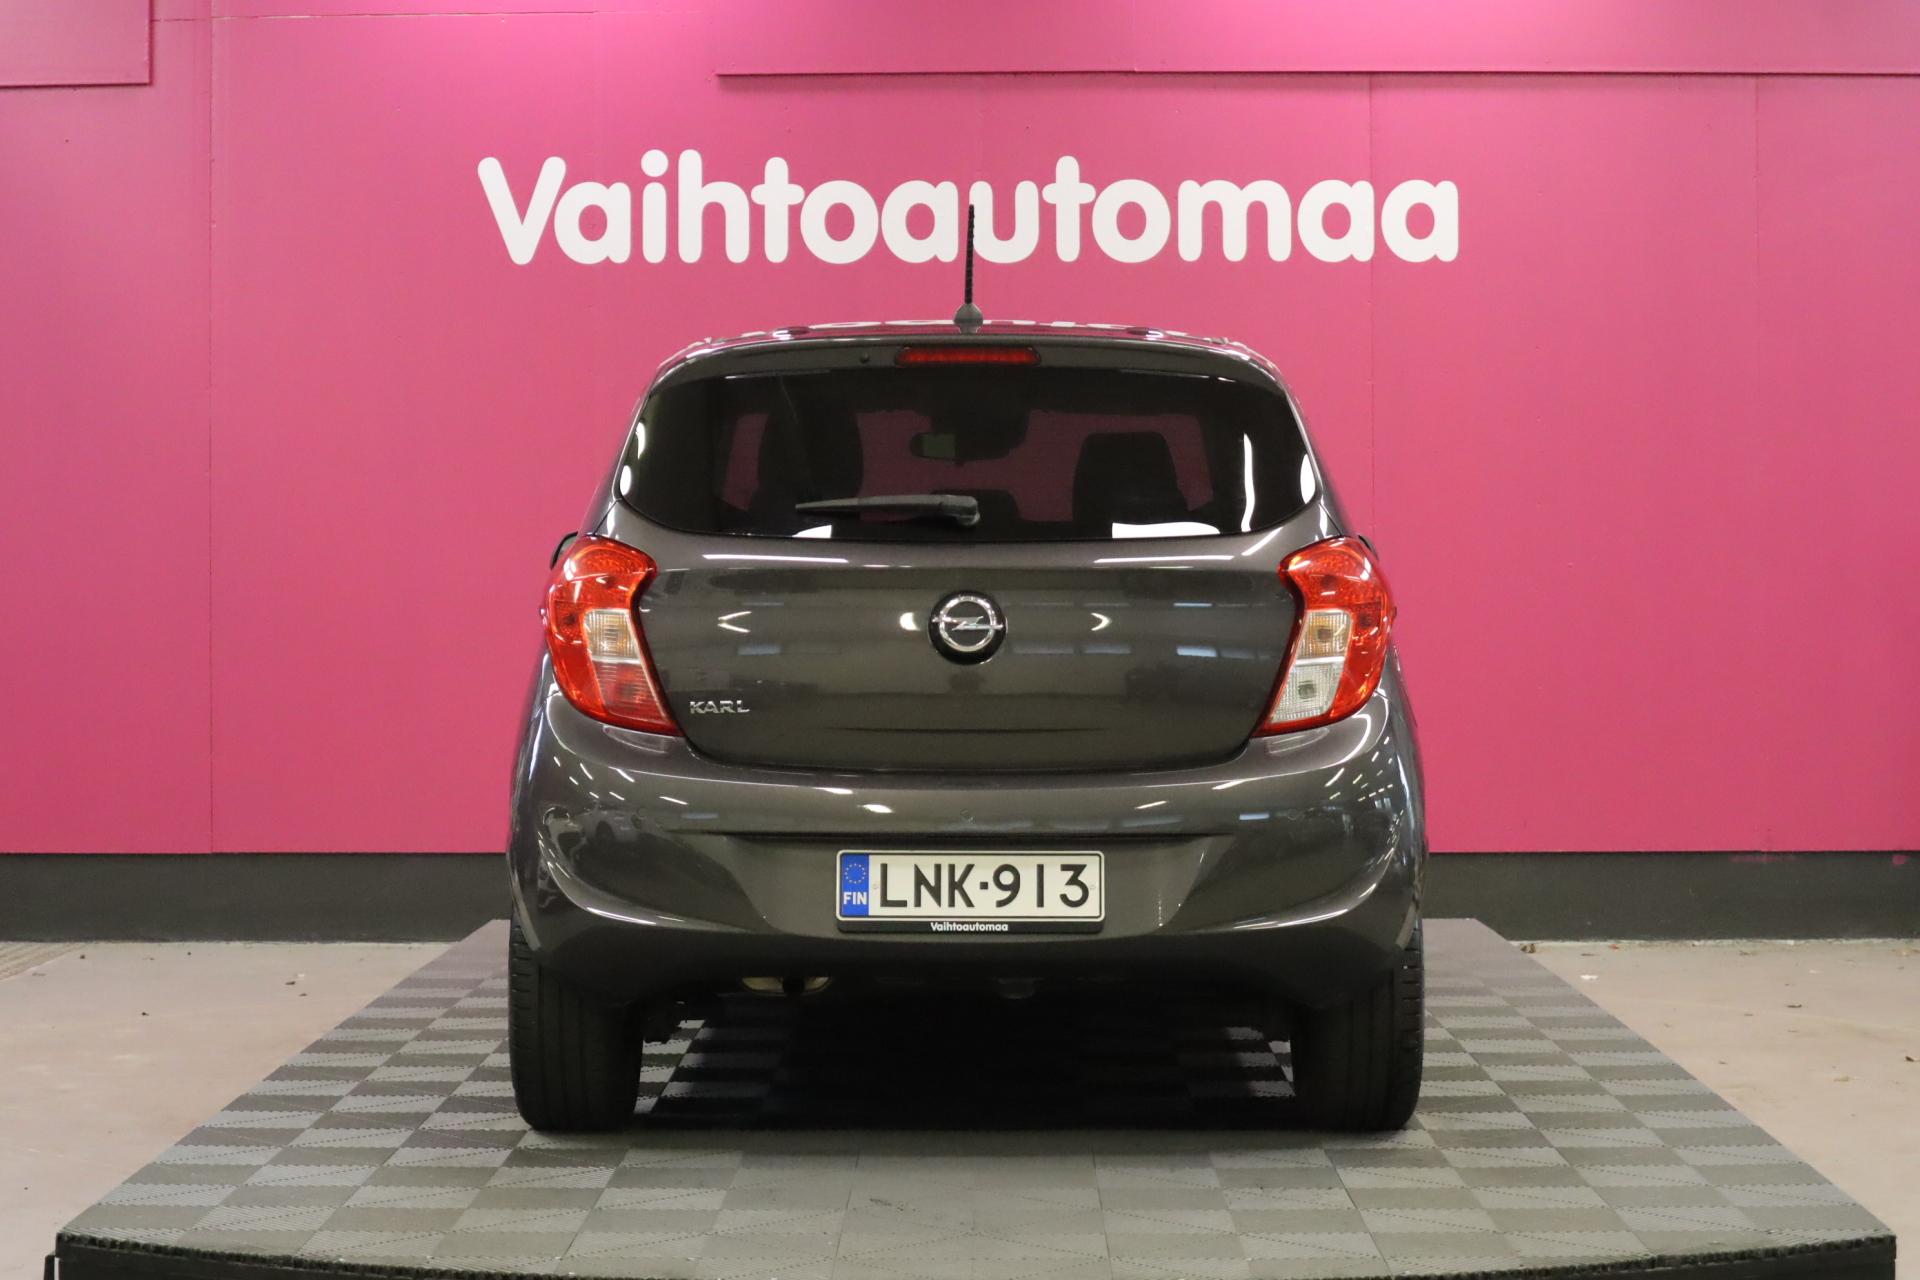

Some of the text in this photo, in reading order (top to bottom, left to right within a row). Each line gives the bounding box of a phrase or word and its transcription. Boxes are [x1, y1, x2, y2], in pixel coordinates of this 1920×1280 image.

[477, 149, 1461, 266] Vaihtoautomaa
[689, 700, 751, 714] KARL
[843, 891, 867, 905] FIN
[930, 922, 1008, 931] Vaihtoautomaa
